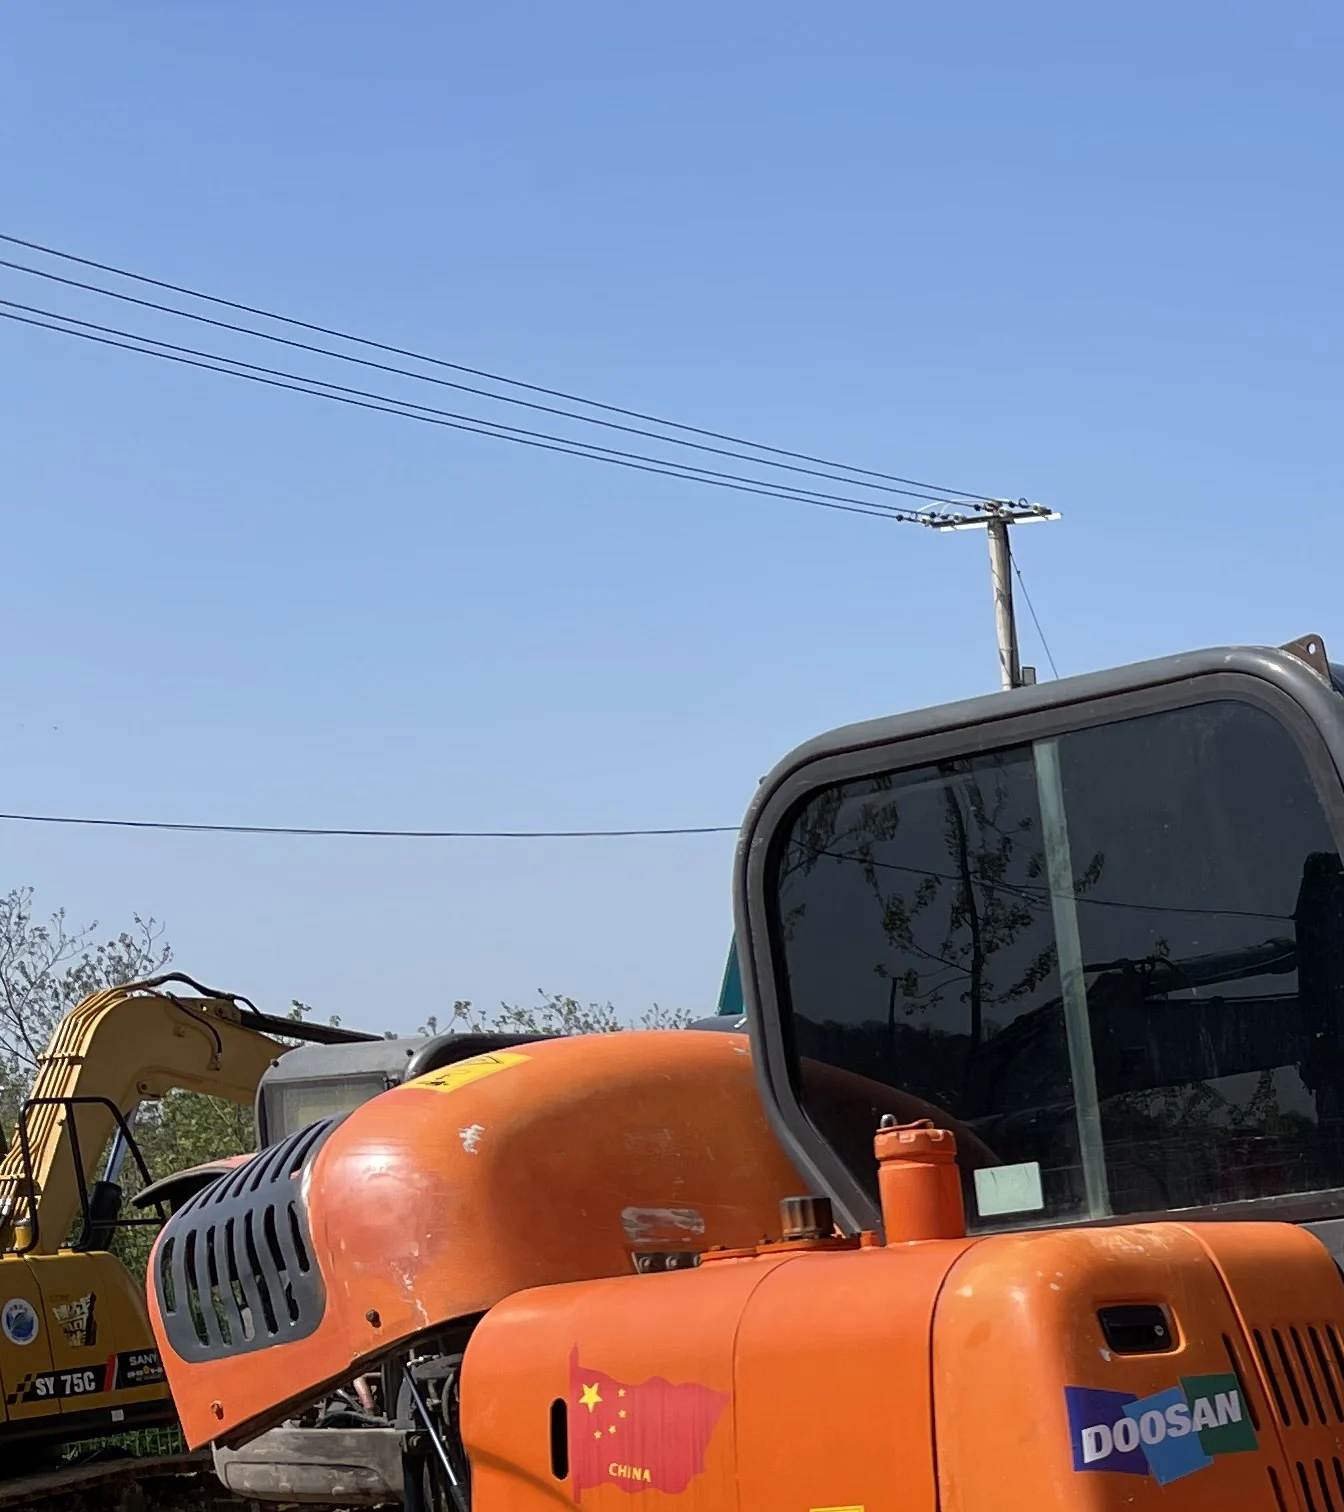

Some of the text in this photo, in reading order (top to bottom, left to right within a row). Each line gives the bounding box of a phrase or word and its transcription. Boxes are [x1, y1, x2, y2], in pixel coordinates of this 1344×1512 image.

[35, 1371, 96, 1396] SY 75C
[1081, 1389, 1242, 1463] DOOSAN
[608, 1463, 652, 1482] CHINA
